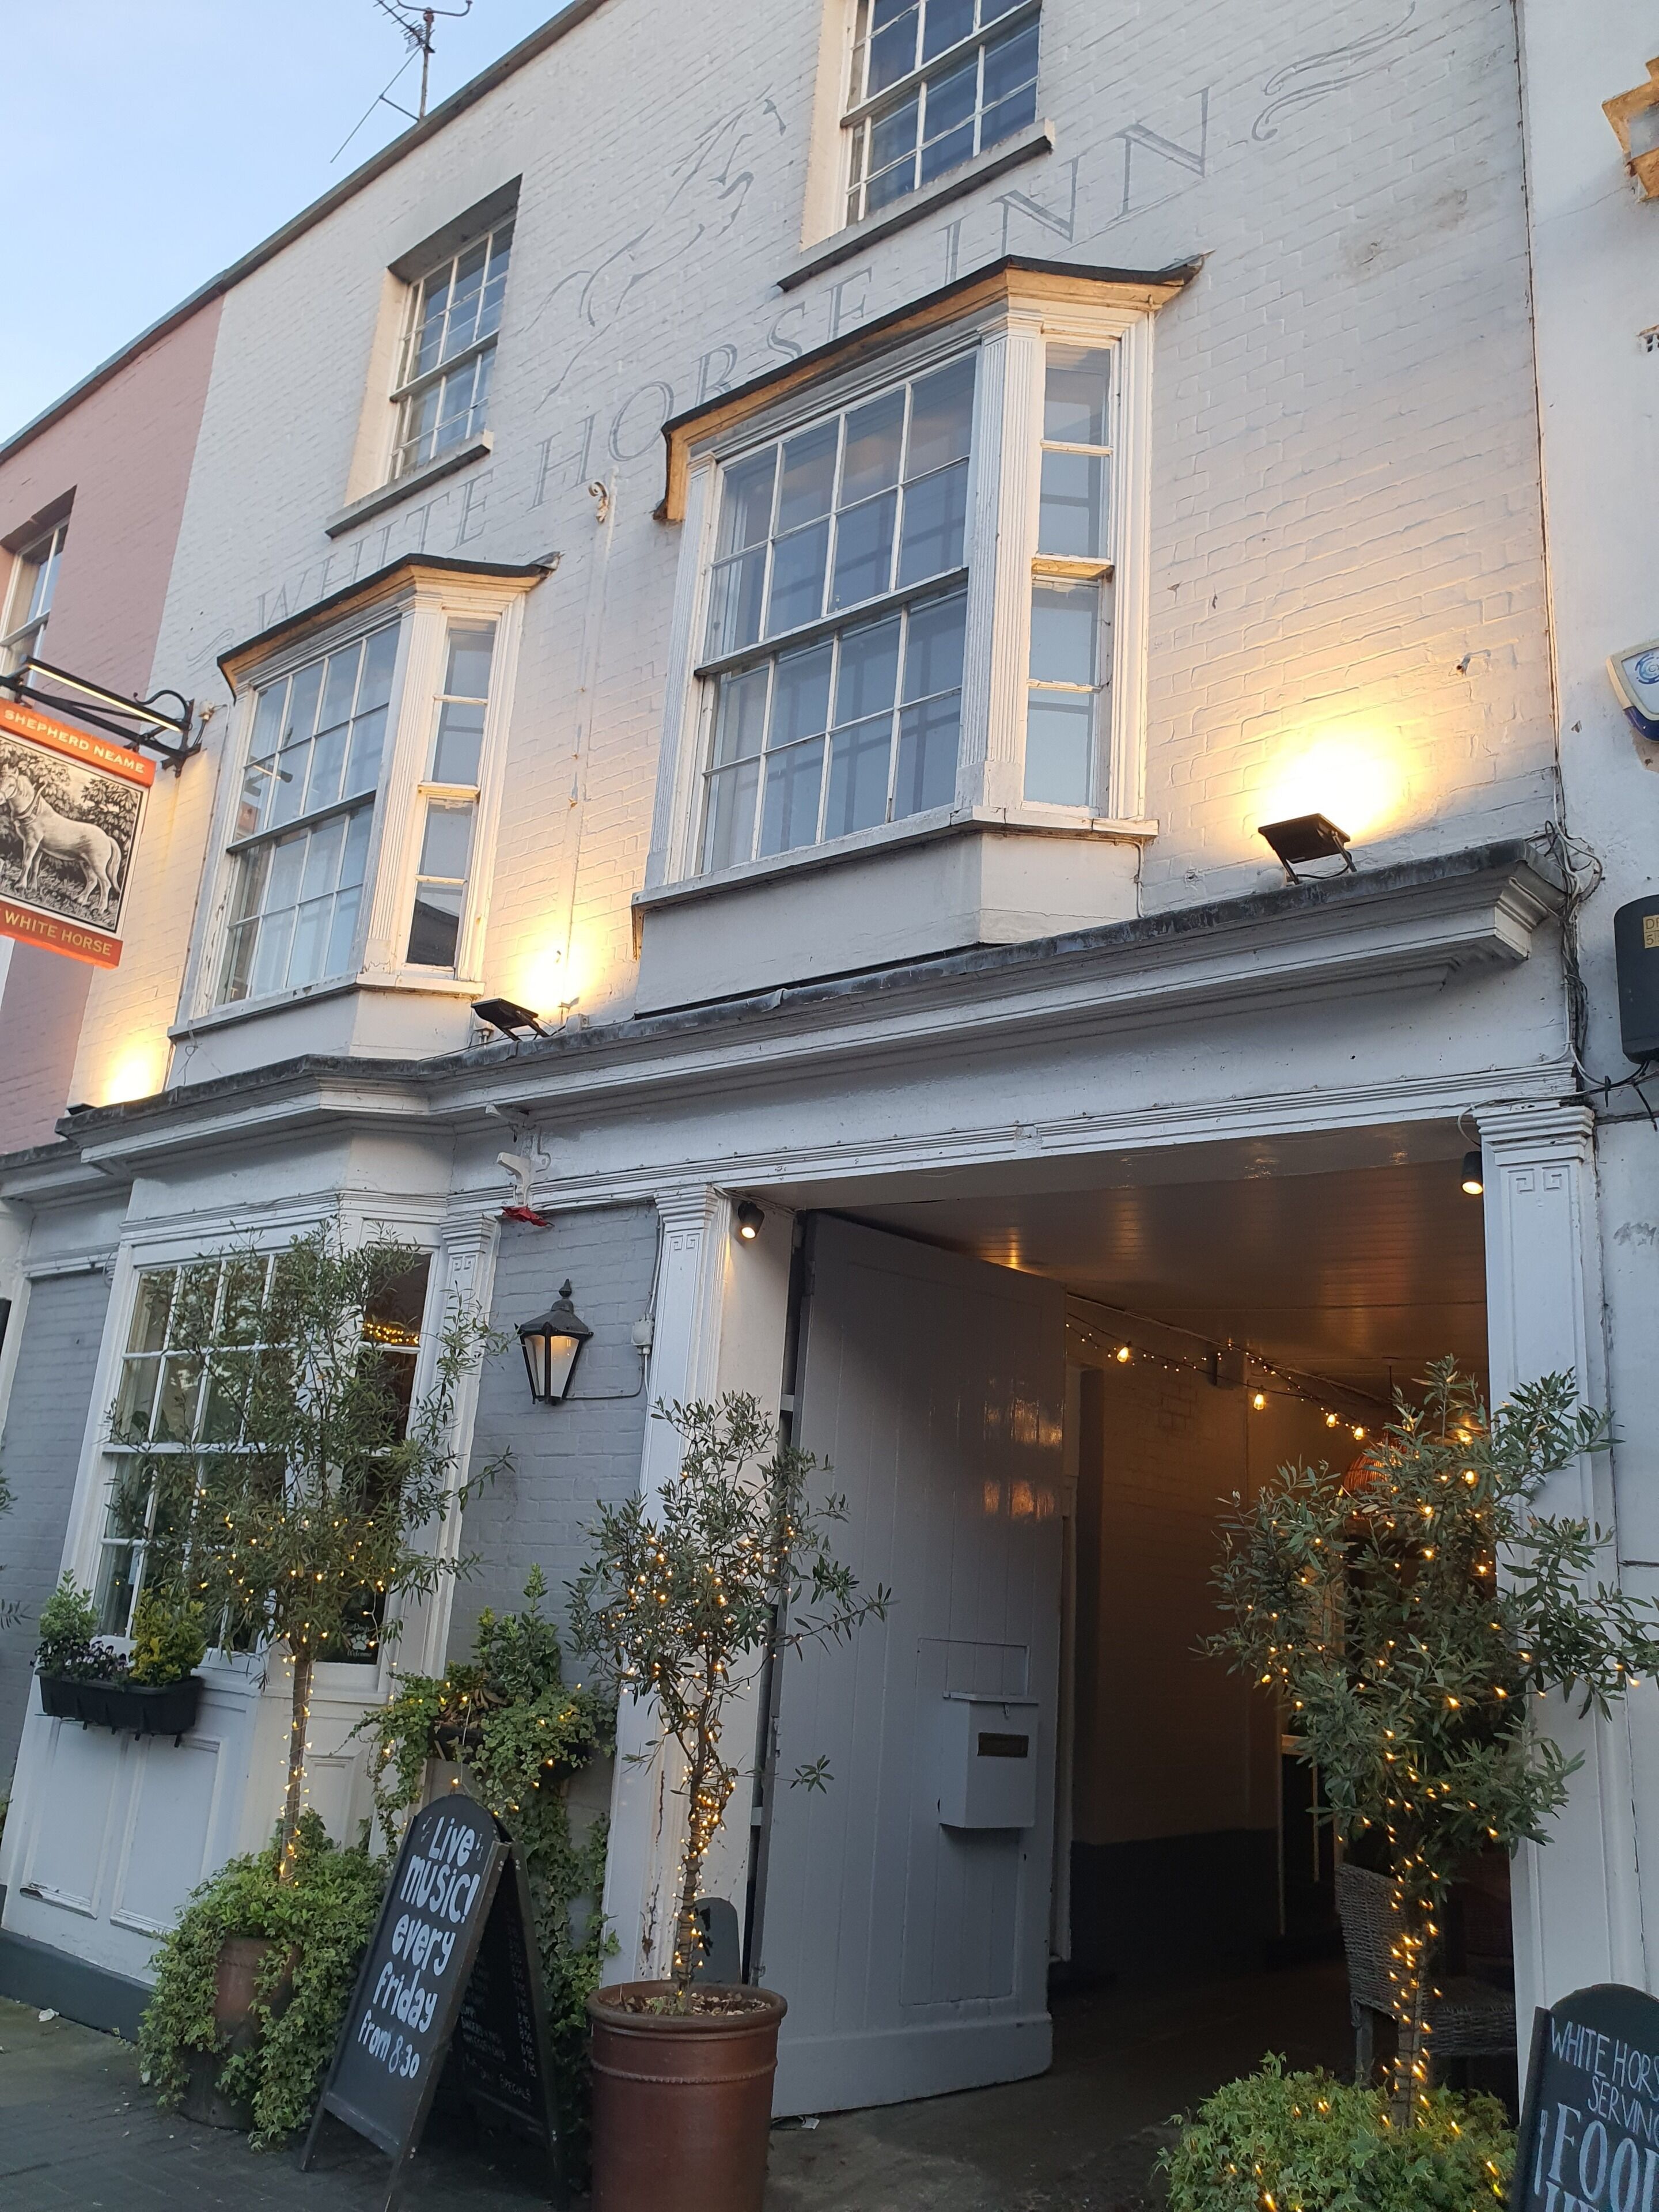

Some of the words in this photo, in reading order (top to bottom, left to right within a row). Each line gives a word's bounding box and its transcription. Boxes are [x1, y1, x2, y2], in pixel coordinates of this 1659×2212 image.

[256, 469, 494, 632] WHITE
[528, 266, 873, 513] HORSE
[937, 86, 1210, 286] INN
[4, 709, 90, 751] SHEPHERD
[93, 744, 145, 774] NEAME
[5, 909, 58, 938] WHITE
[61, 929, 113, 956] HORSE
[429, 1816, 475, 1867] Live
[400, 1854, 480, 1924] music!
[392, 1914, 456, 1976] every
[373, 1961, 438, 2033] friday
[358, 2009, 392, 2062] from
[388, 2035, 420, 2079] 8:30
[1551, 2017, 1610, 2078] WHITE
